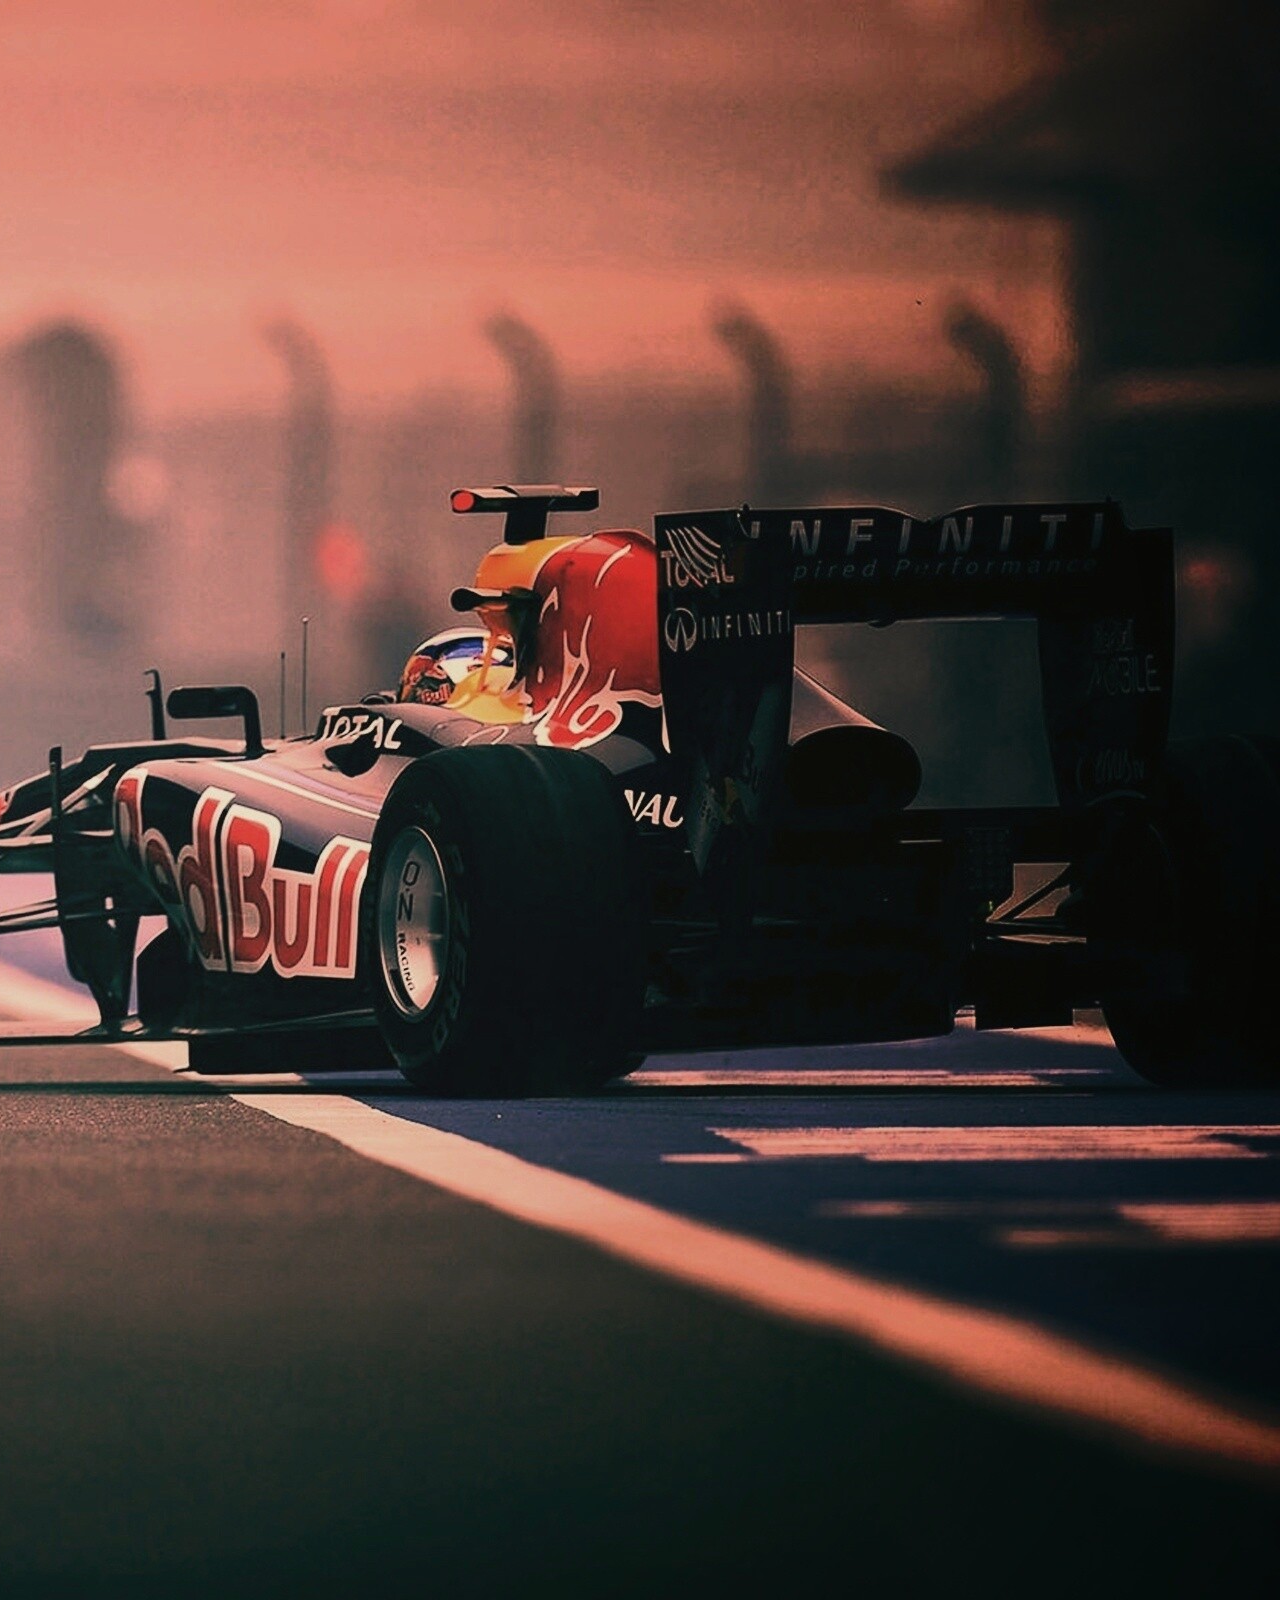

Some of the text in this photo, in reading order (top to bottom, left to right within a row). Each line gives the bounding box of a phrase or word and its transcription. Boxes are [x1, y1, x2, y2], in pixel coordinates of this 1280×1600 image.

[702, 610, 791, 640] INFINITI
[320, 706, 403, 750] TOTAL
[222, 804, 372, 979] Bull
